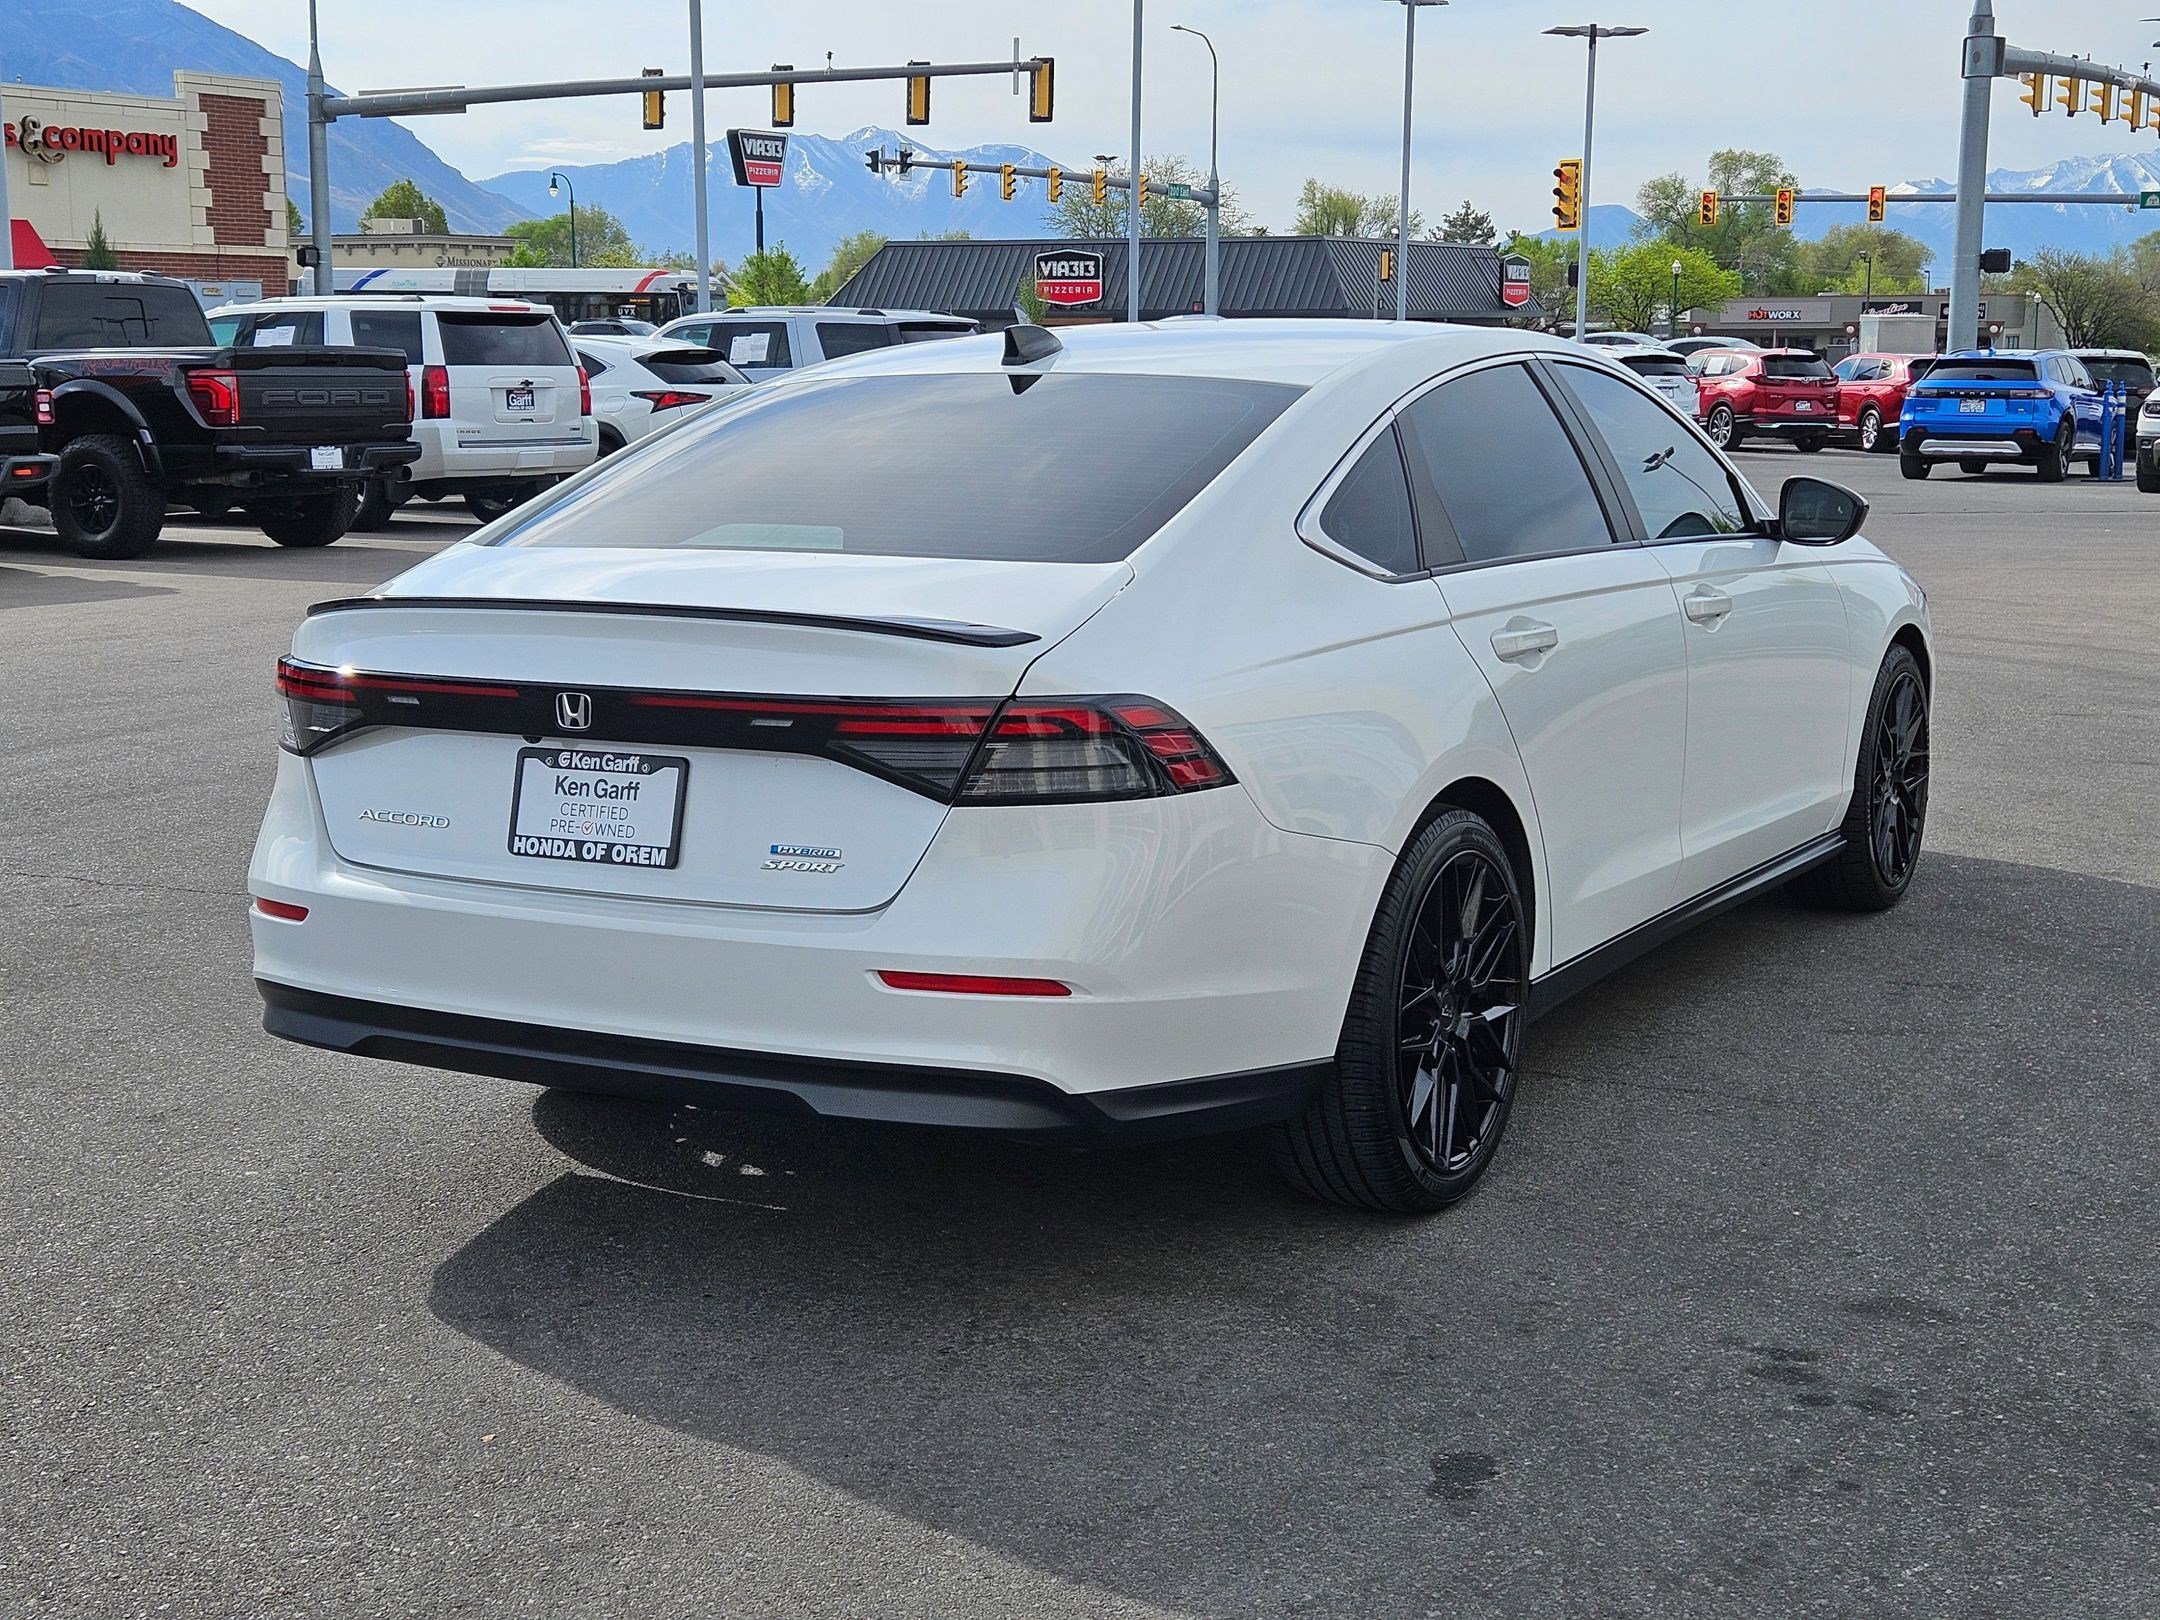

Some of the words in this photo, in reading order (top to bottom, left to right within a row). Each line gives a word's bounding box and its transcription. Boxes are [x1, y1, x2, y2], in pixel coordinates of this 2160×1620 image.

[748, 166, 779, 176] PIZZERIA
[1180, 186, 1191, 197] East
[1043, 286, 1093, 294] PIZZERIA
[617, 308, 636, 316] UYX
[1748, 307, 1800, 320] HOTWORX
[262, 390, 390, 405] FORD
[508, 393, 533, 406] Garff
[571, 752, 600, 769] Ken
[601, 754, 640, 773] Garff
[554, 774, 591, 797] Ken
[594, 778, 641, 802] Garff
[359, 808, 450, 828] ACCORD
[560, 802, 629, 821] CERTIFIED
[512, 836, 577, 858] HONDA
[581, 842, 608, 860] OF
[611, 844, 667, 866] OREM
[779, 846, 836, 857] HYBRID
[760, 859, 845, 873] SPORT
